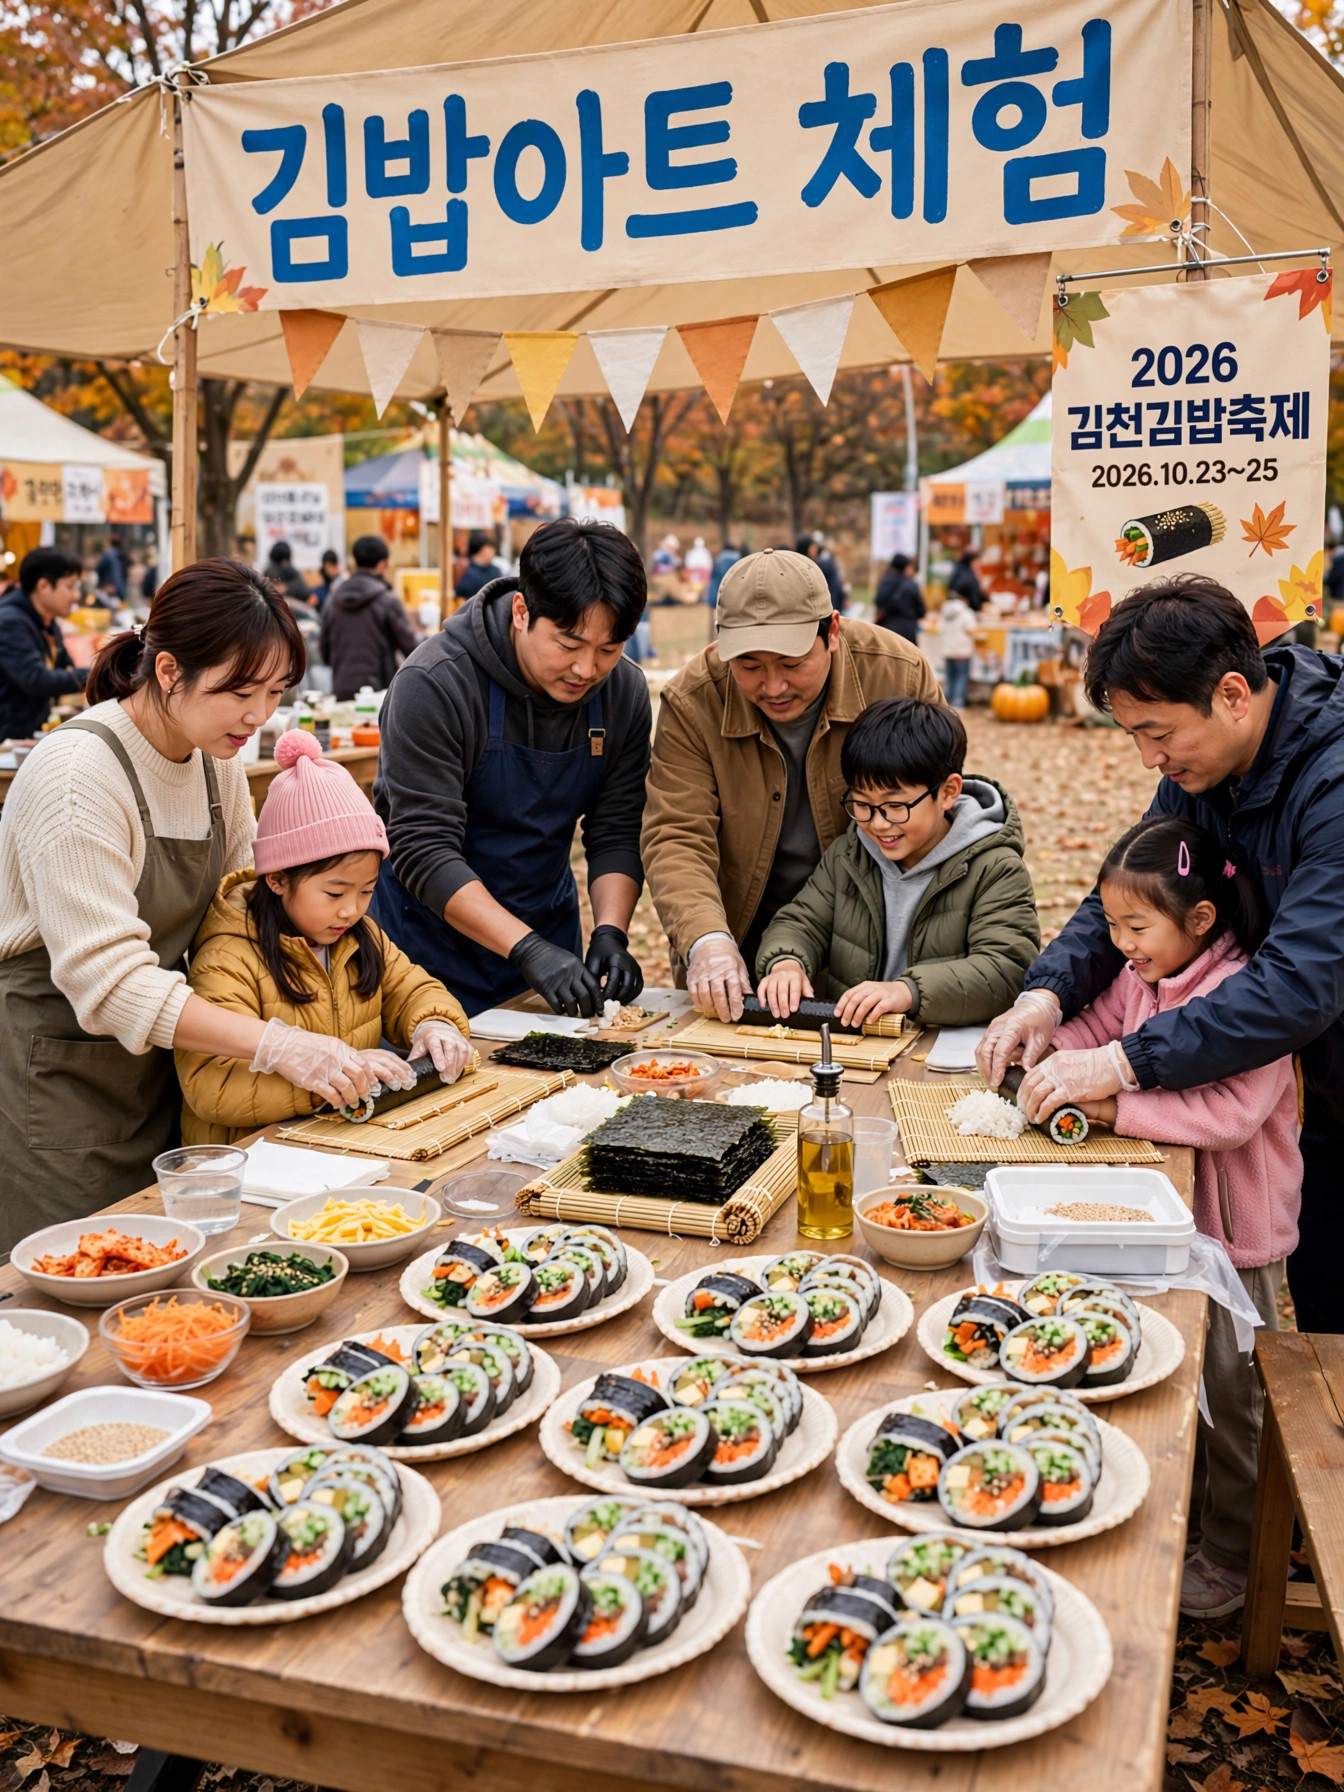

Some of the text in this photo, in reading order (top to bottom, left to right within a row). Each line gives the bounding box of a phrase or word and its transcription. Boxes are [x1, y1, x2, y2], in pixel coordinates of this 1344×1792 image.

[241, 18, 1112, 284] 김밥아트 체험
[1131, 341, 1238, 388] 2026
[1067, 391, 1310, 451] 김천김밥축제
[1091, 457, 1279, 488] 2026.10.23~25
